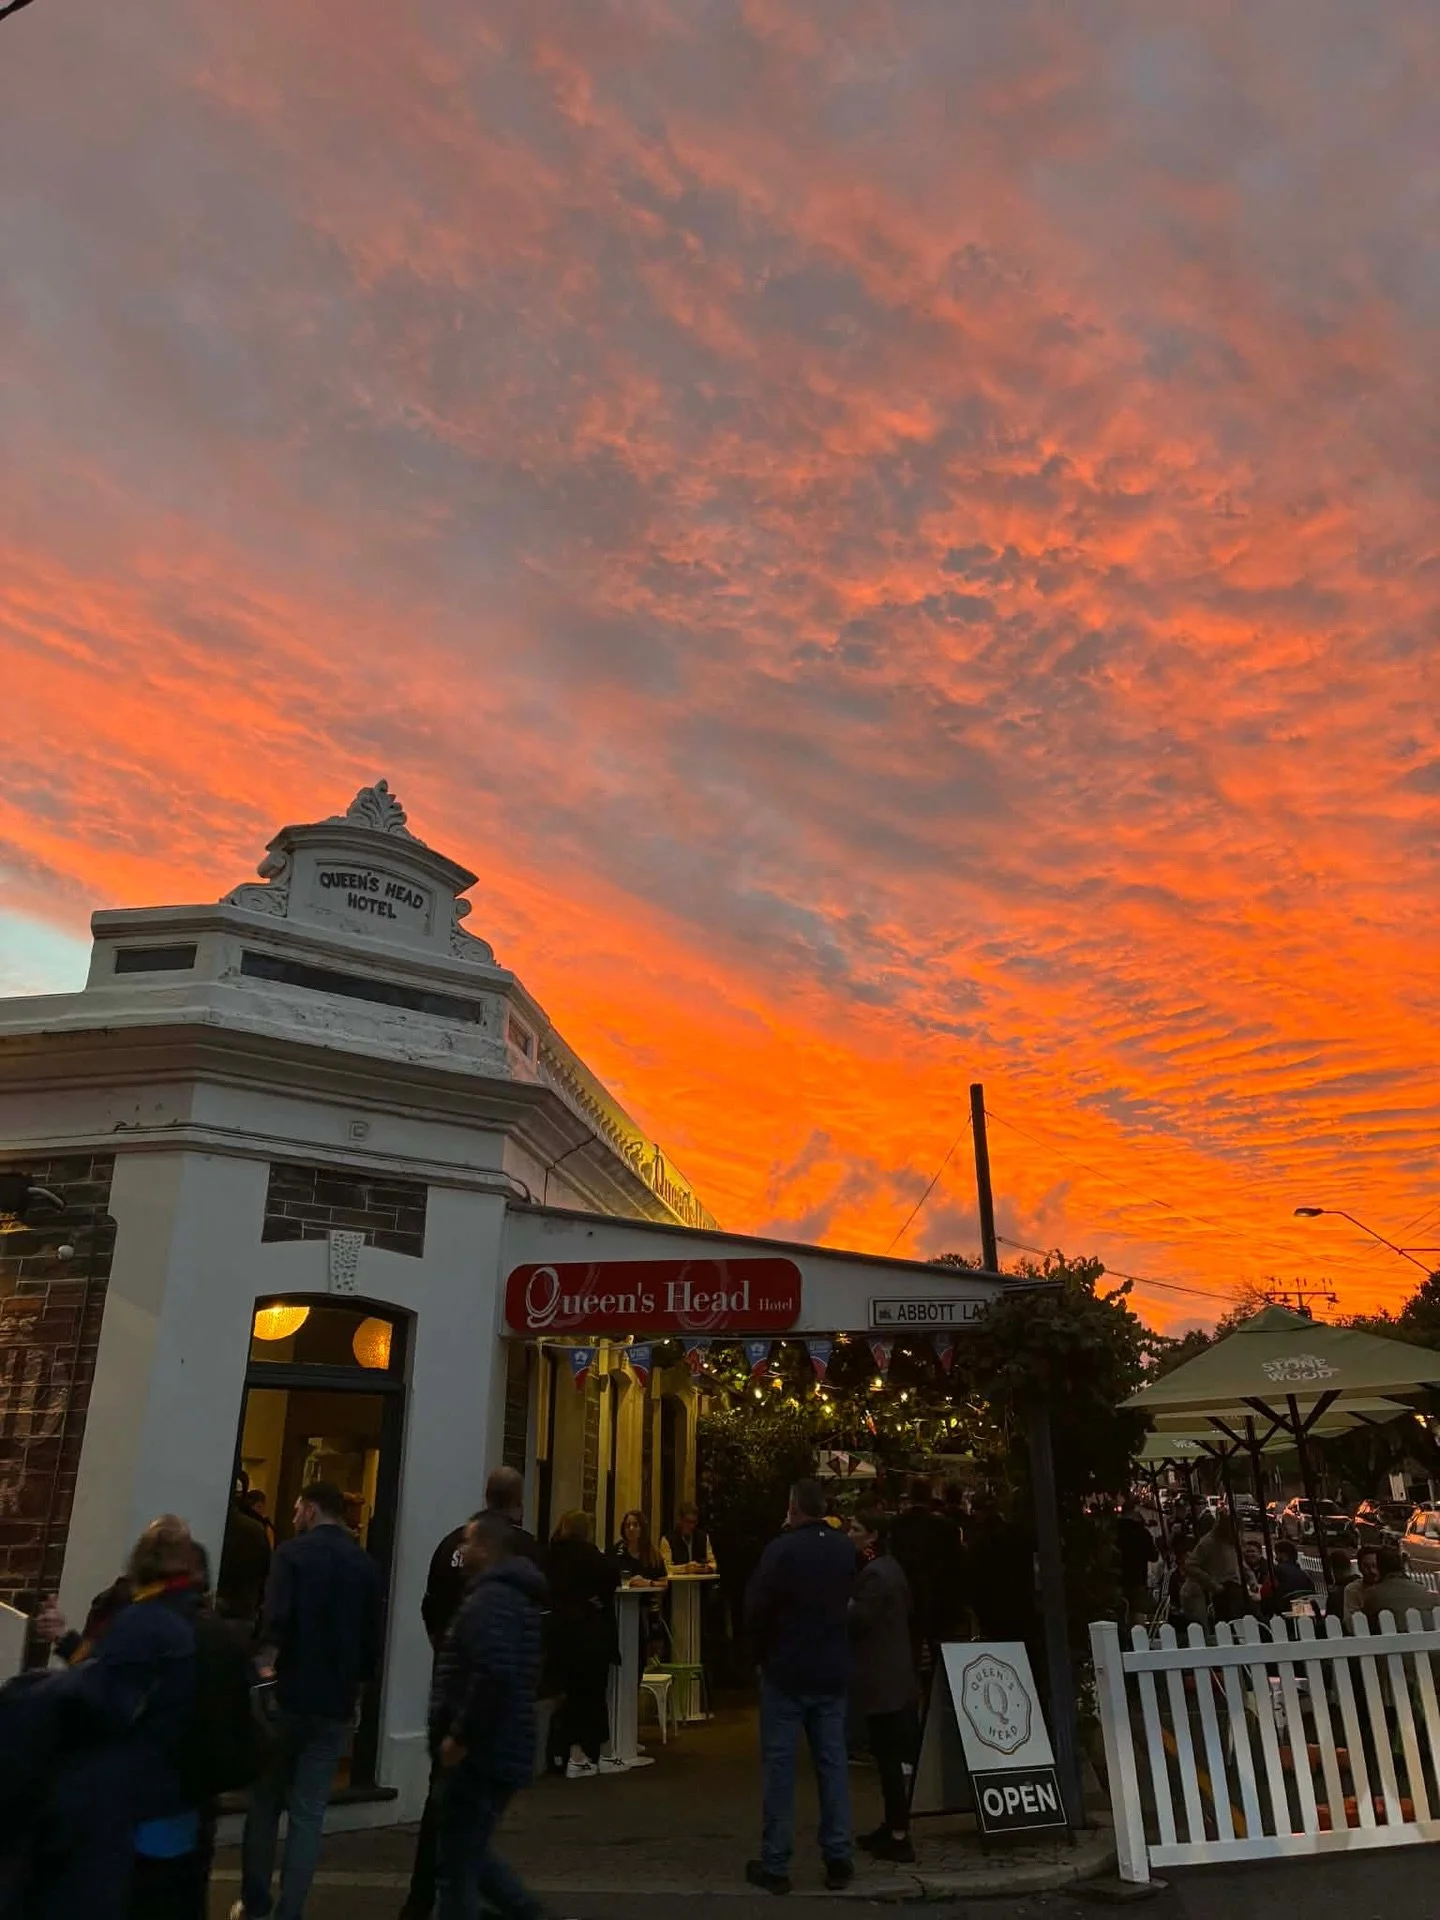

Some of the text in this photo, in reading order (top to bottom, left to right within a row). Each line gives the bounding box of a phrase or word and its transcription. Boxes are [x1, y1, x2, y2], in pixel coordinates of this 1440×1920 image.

[320, 872, 424, 909] QUEEN'S HEAD
[525, 1266, 793, 1328] Queen's Head Hotel
[897, 1302, 984, 1321] ABBOTT LA
[1262, 1357, 1329, 1373] STONE
[1267, 1369, 1334, 1382] WOOD
[989, 1725, 1018, 1740] HEAD
[983, 1784, 1057, 1817] OPEN
